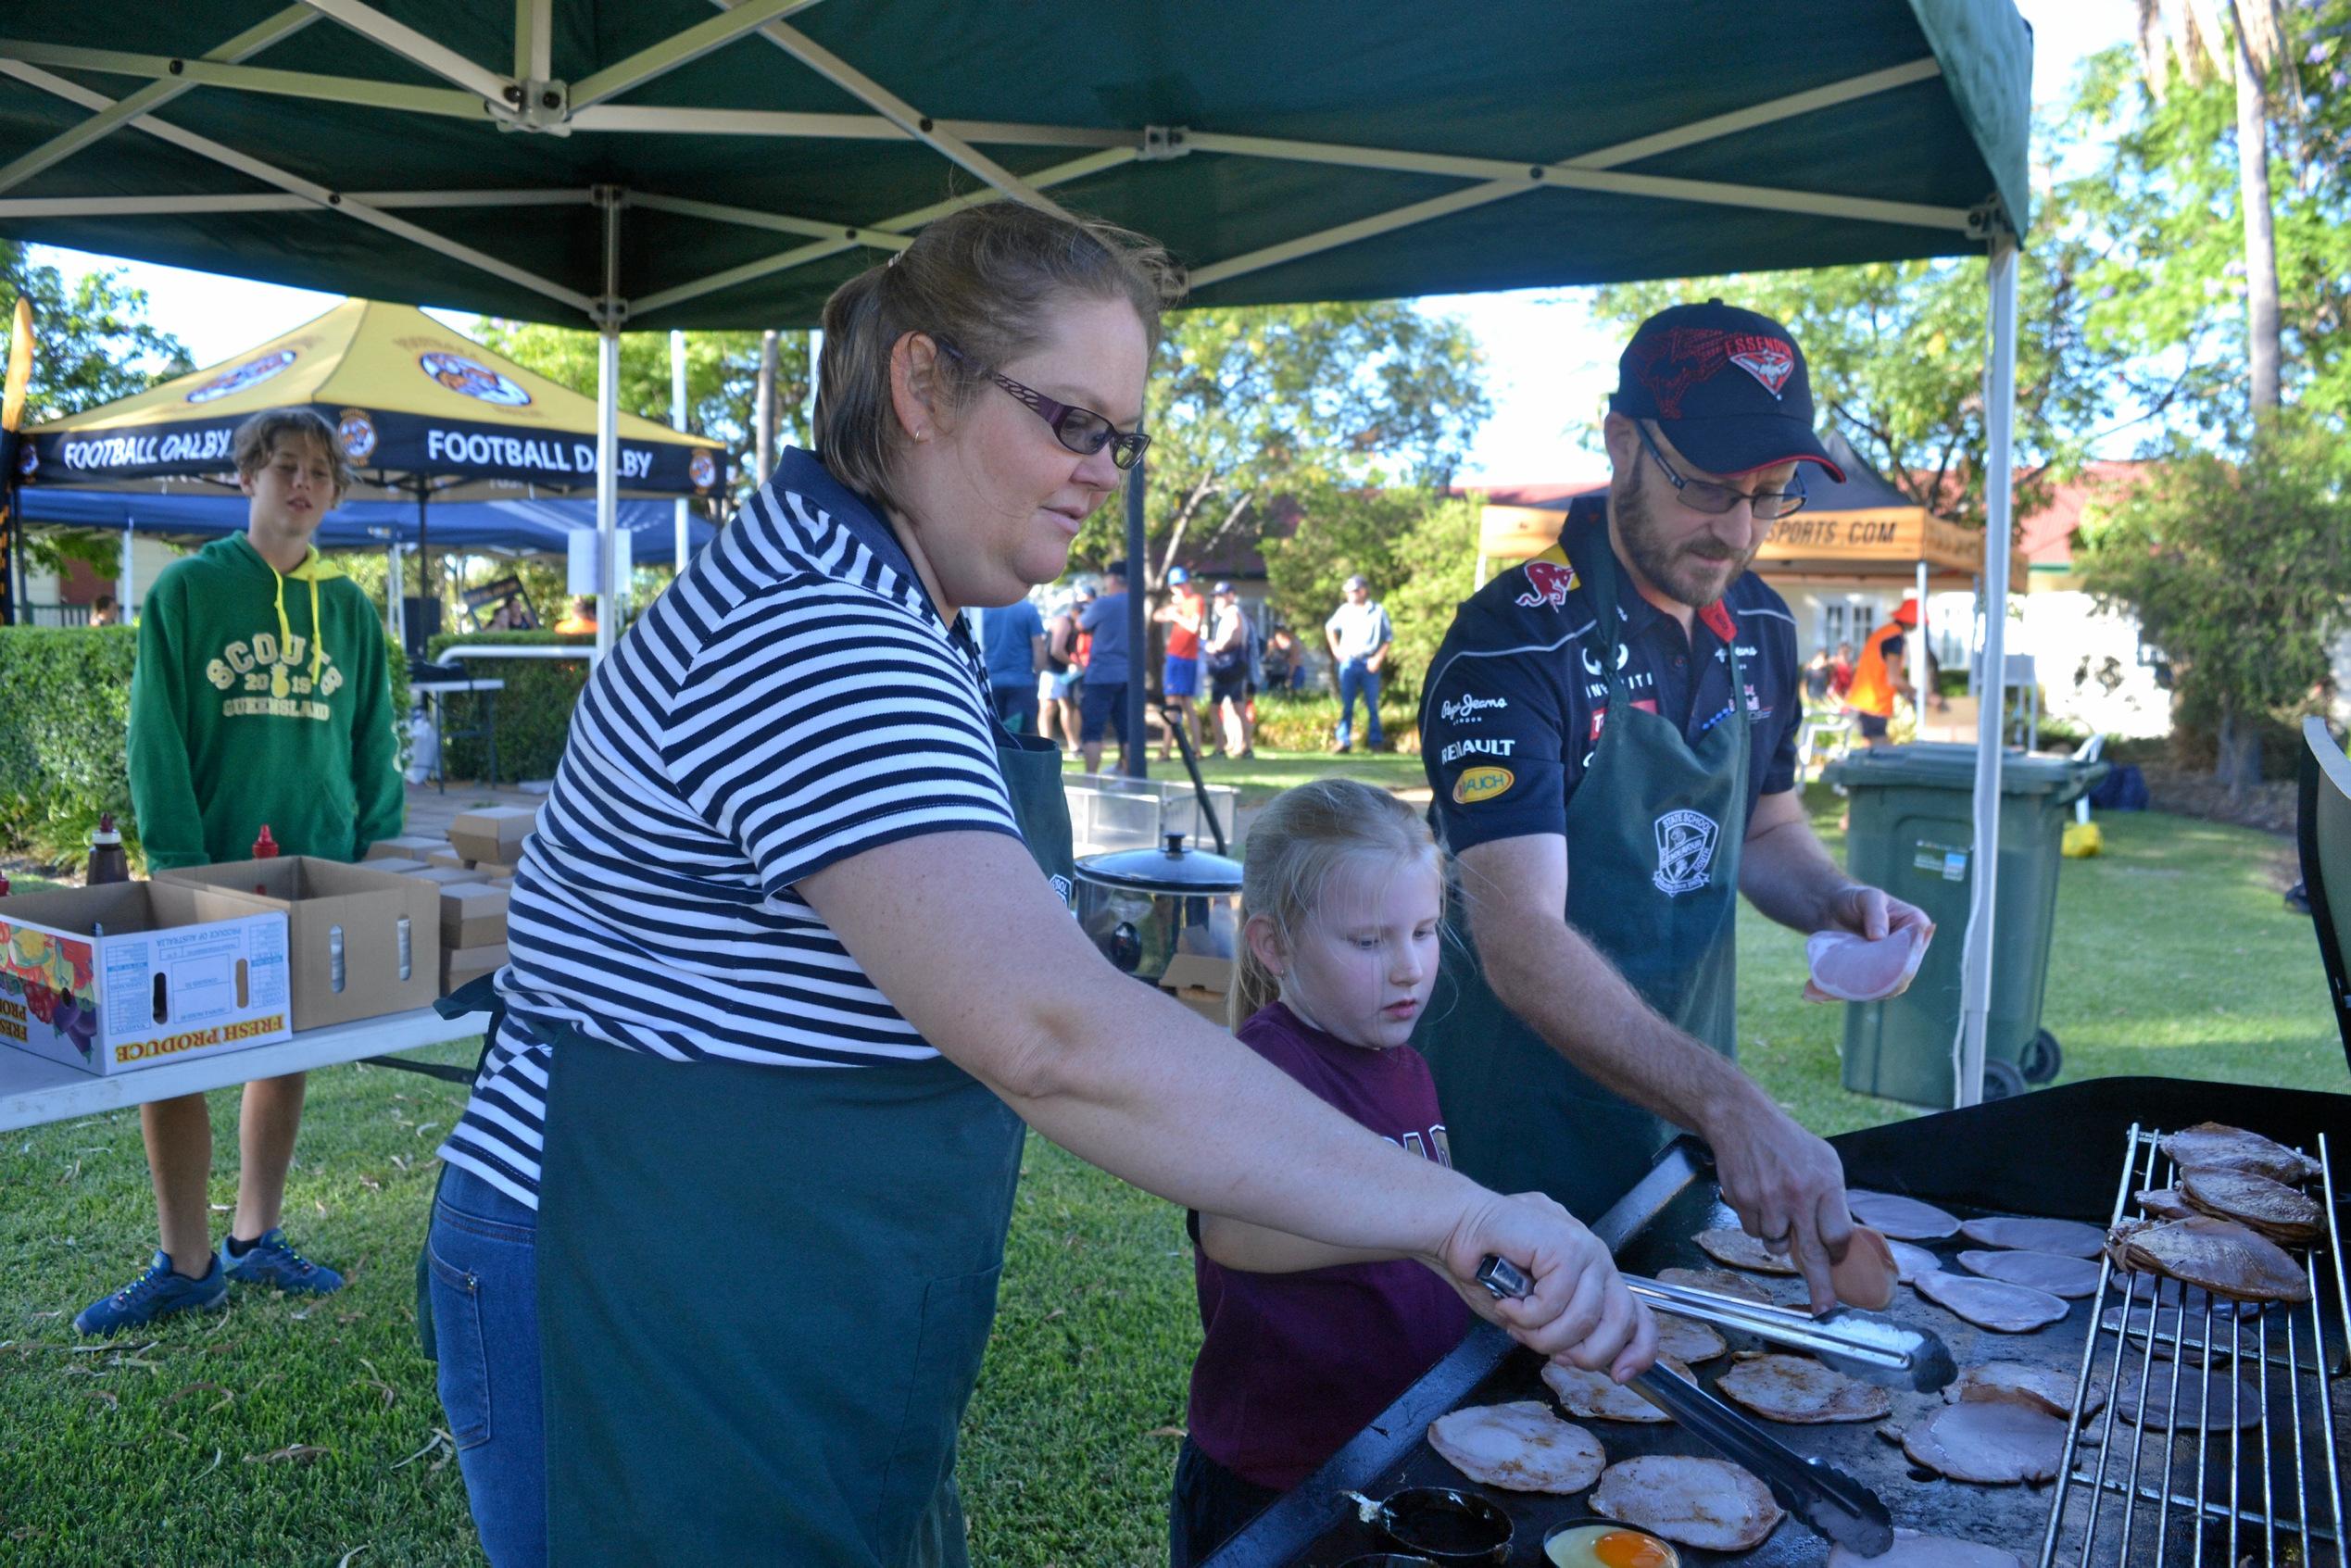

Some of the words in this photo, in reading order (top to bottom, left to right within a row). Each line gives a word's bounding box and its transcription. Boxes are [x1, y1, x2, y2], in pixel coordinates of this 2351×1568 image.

[64, 436, 157, 470] FOOTBALL
[427, 430, 572, 472] FOOTBALL
[222, 697, 331, 721] QUEENSLAND
[1460, 694, 1508, 717] Jeans
[1662, 813, 1682, 828] STATE
[222, 1014, 285, 1038] FRESH
[115, 1031, 219, 1063] PRODUCE
